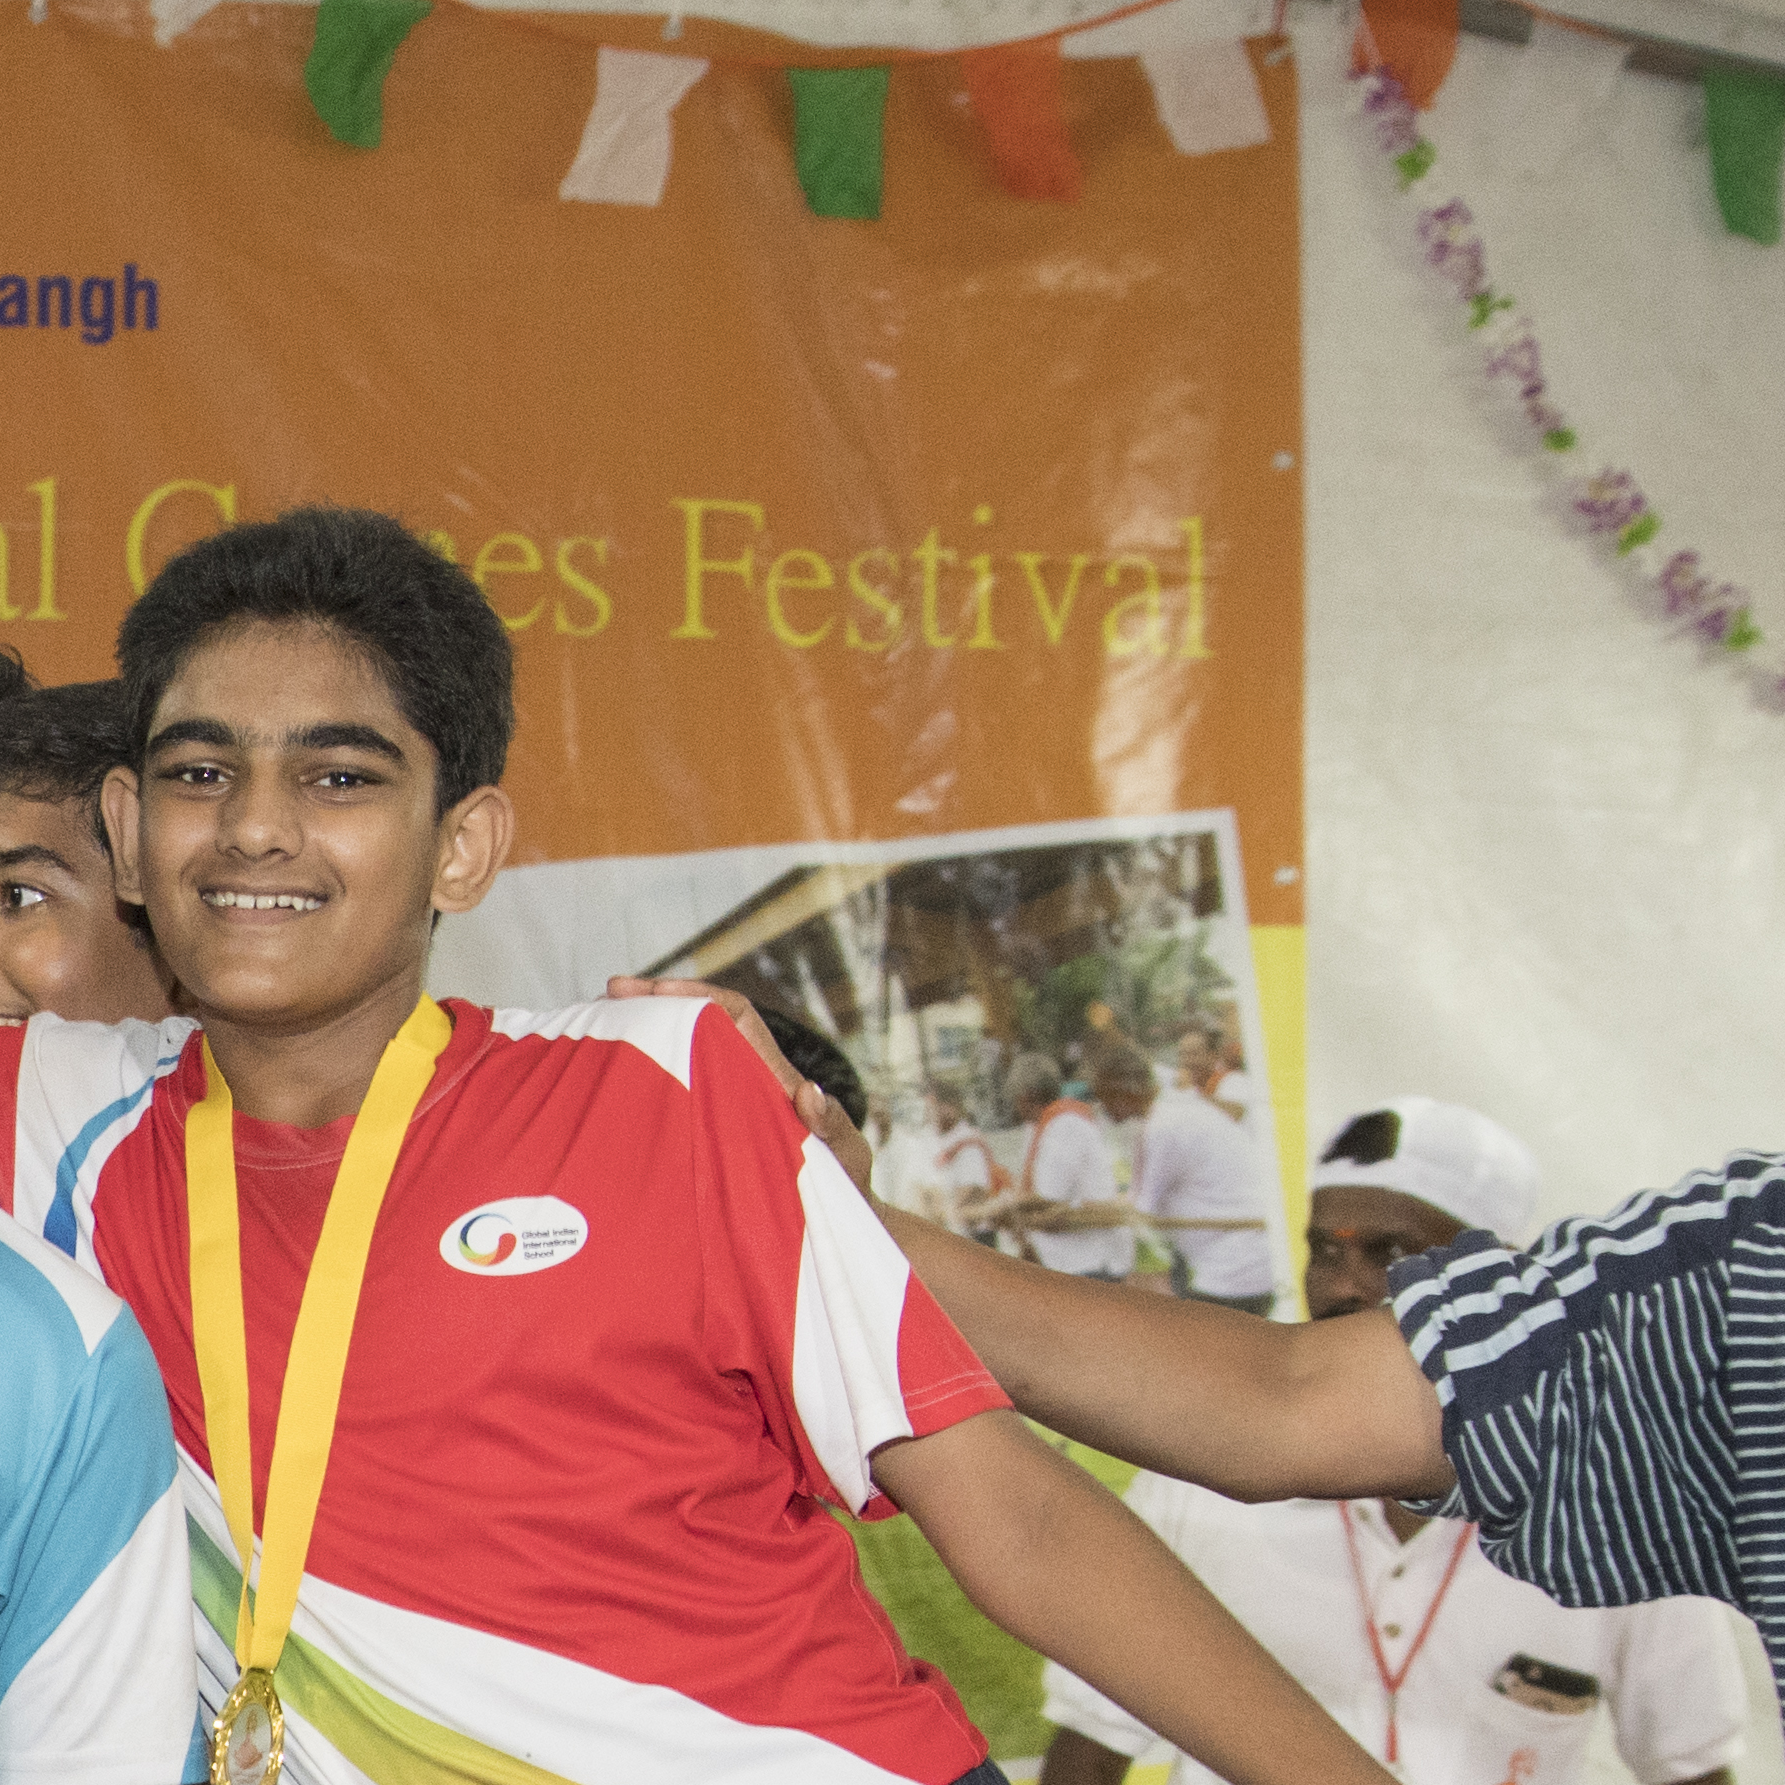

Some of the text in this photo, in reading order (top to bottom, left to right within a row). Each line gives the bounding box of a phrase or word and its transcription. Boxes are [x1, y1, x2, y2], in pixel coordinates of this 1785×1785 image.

[669, 497, 1214, 660] Festival
[521, 1228, 579, 1240] Global Indian
[523, 1238, 577, 1249] International
[524, 1249, 554, 1260] School
